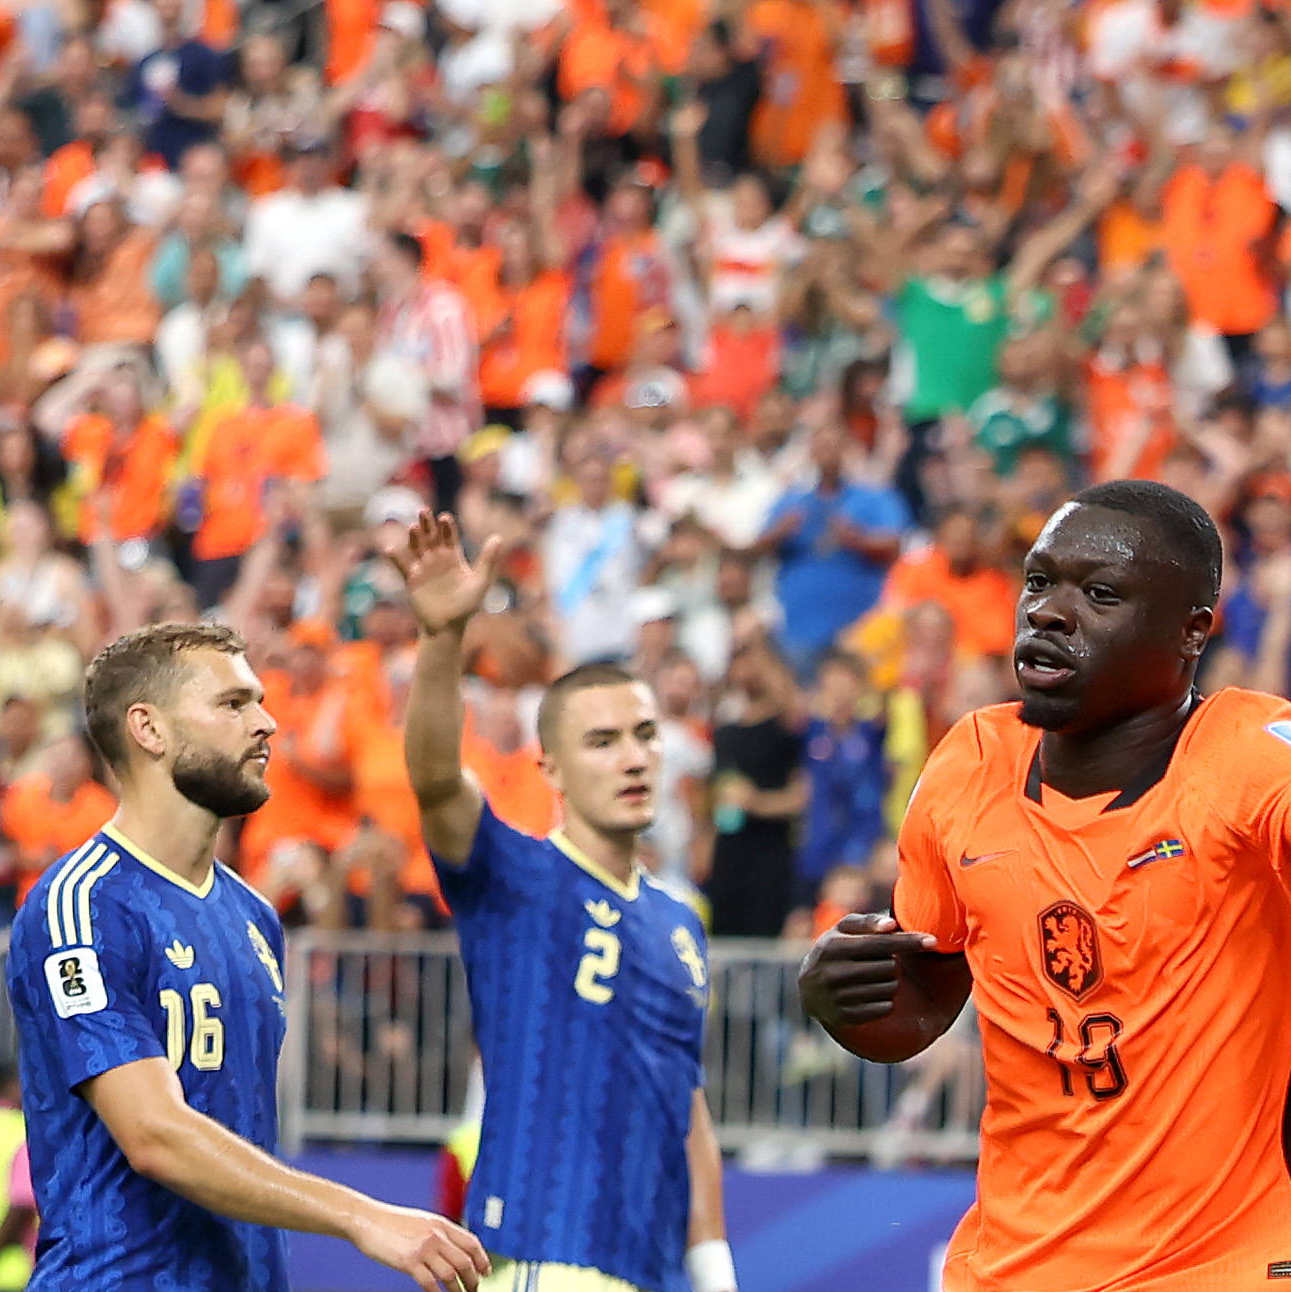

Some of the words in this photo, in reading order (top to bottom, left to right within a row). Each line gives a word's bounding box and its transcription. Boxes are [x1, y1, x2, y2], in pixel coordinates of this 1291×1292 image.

[574, 927, 622, 1005] 2
[159, 983, 224, 1071] 16
[1047, 1007, 1129, 1101] 19
